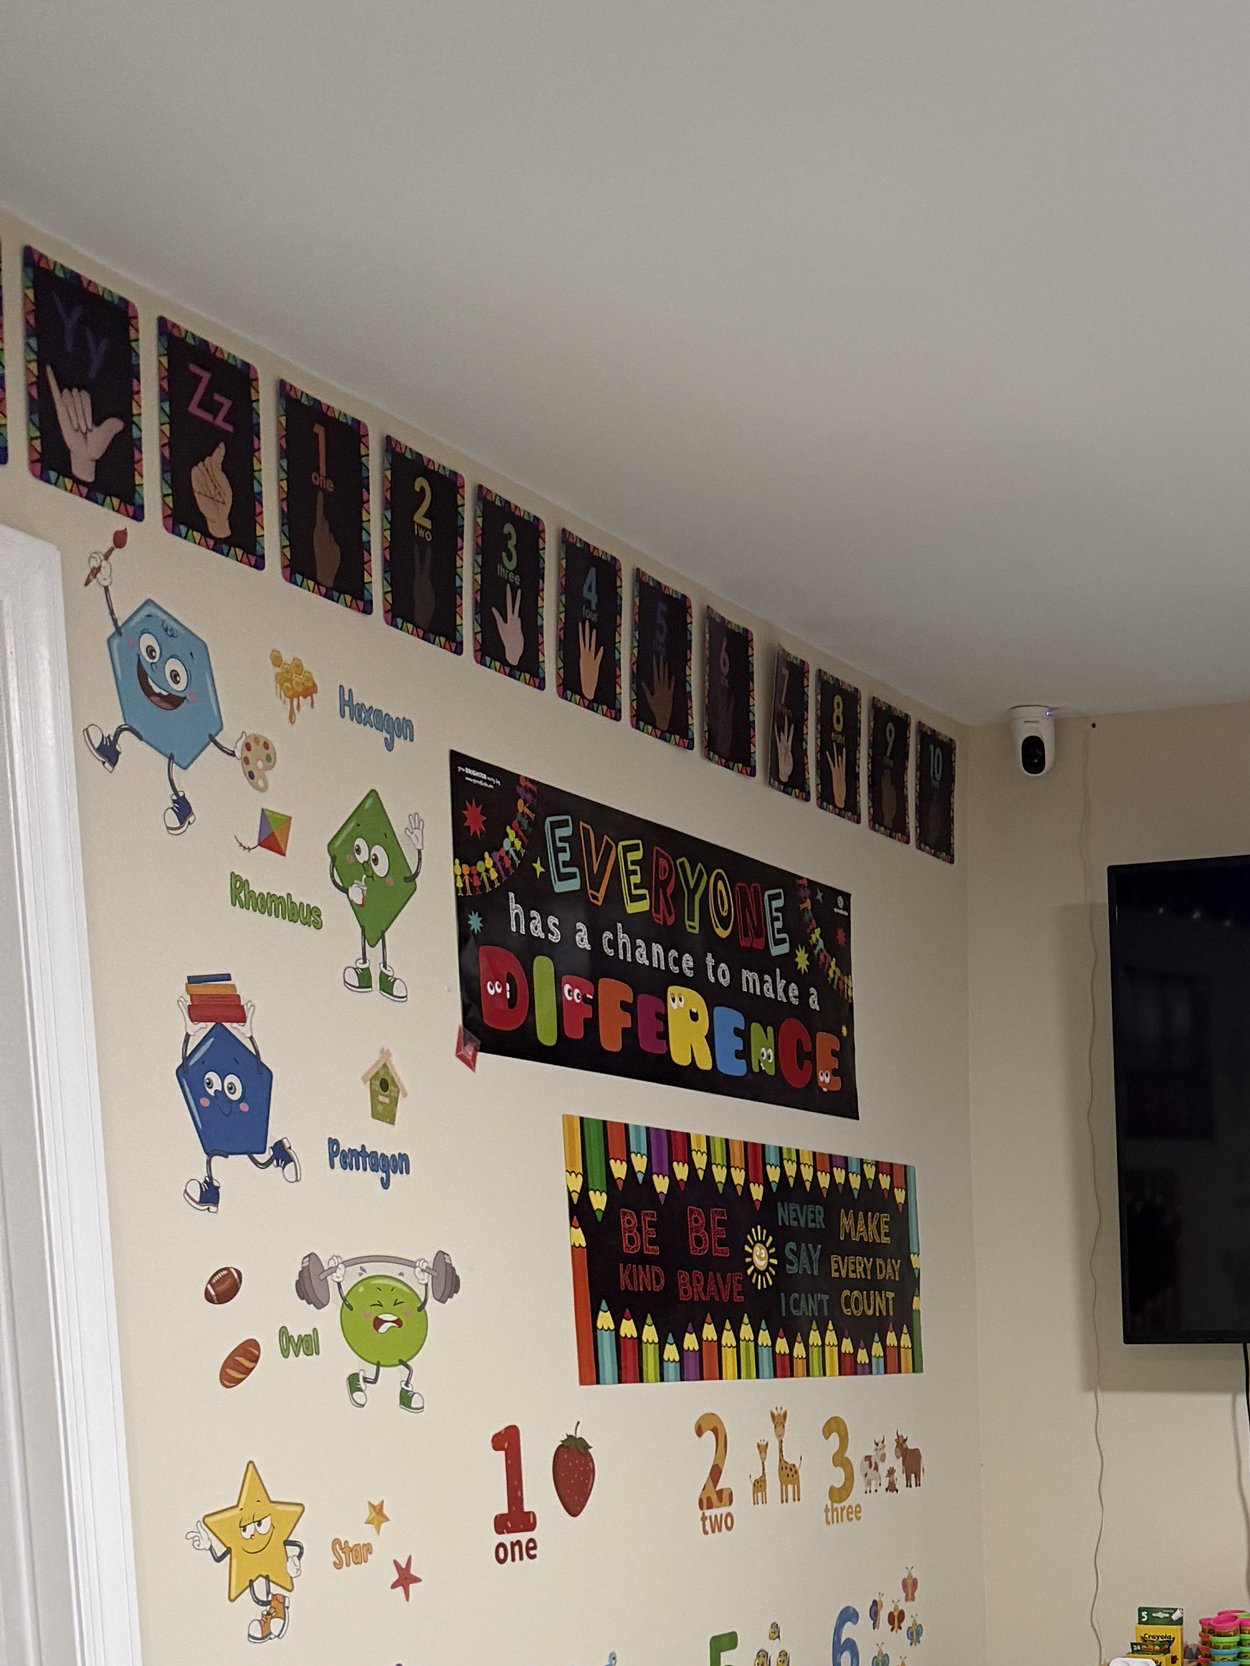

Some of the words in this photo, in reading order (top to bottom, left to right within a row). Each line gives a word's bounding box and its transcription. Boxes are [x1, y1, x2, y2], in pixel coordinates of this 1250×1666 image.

[187, 363, 234, 433] Zz
[313, 423, 327, 478] 1
[414, 476, 432, 529] 2
[502, 522, 518, 571] 3
[582, 566, 598, 611] 4
[720, 633, 730, 676] 6
[338, 684, 415, 752] Hexagon
[832, 694, 845, 732] 8
[885, 721, 896, 757] 9
[929, 744, 943, 782] 10
[230, 871, 323, 930] Rhombus
[544, 815, 790, 956] EVERYONE
[508, 891, 561, 945] has
[575, 920, 592, 952] a
[602, 922, 695, 978] chance
[705, 951, 731, 988] to
[741, 967, 800, 1008] make
[808, 984, 821, 1013] a
[477, 944, 842, 1092] DIFFERENCE
[327, 1137, 410, 1189] Pentagon
[619, 1208, 660, 1256] BE
[687, 1205, 730, 1258] BE
[777, 1201, 826, 1229] NEVER
[839, 1209, 892, 1244] MAKE
[618, 1263, 665, 1292] KIND
[784, 1241, 821, 1276] SAY
[830, 1254, 876, 1281] EVERY
[877, 1258, 901, 1282] DAY
[677, 1270, 745, 1303] BRAVE
[780, 1293, 787, 1316] I
[789, 1293, 830, 1317] CAN'T
[840, 1290, 895, 1317] COUNT
[278, 1325, 320, 1359] Oval
[694, 1412, 734, 1511] 2
[822, 1415, 855, 1504] 3
[491, 1425, 538, 1535] 1
[700, 1510, 735, 1536] two
[823, 1502, 862, 1526] three
[331, 1537, 374, 1570] Star
[493, 1537, 538, 1564] one
[1141, 1611, 1148, 1621] 5
